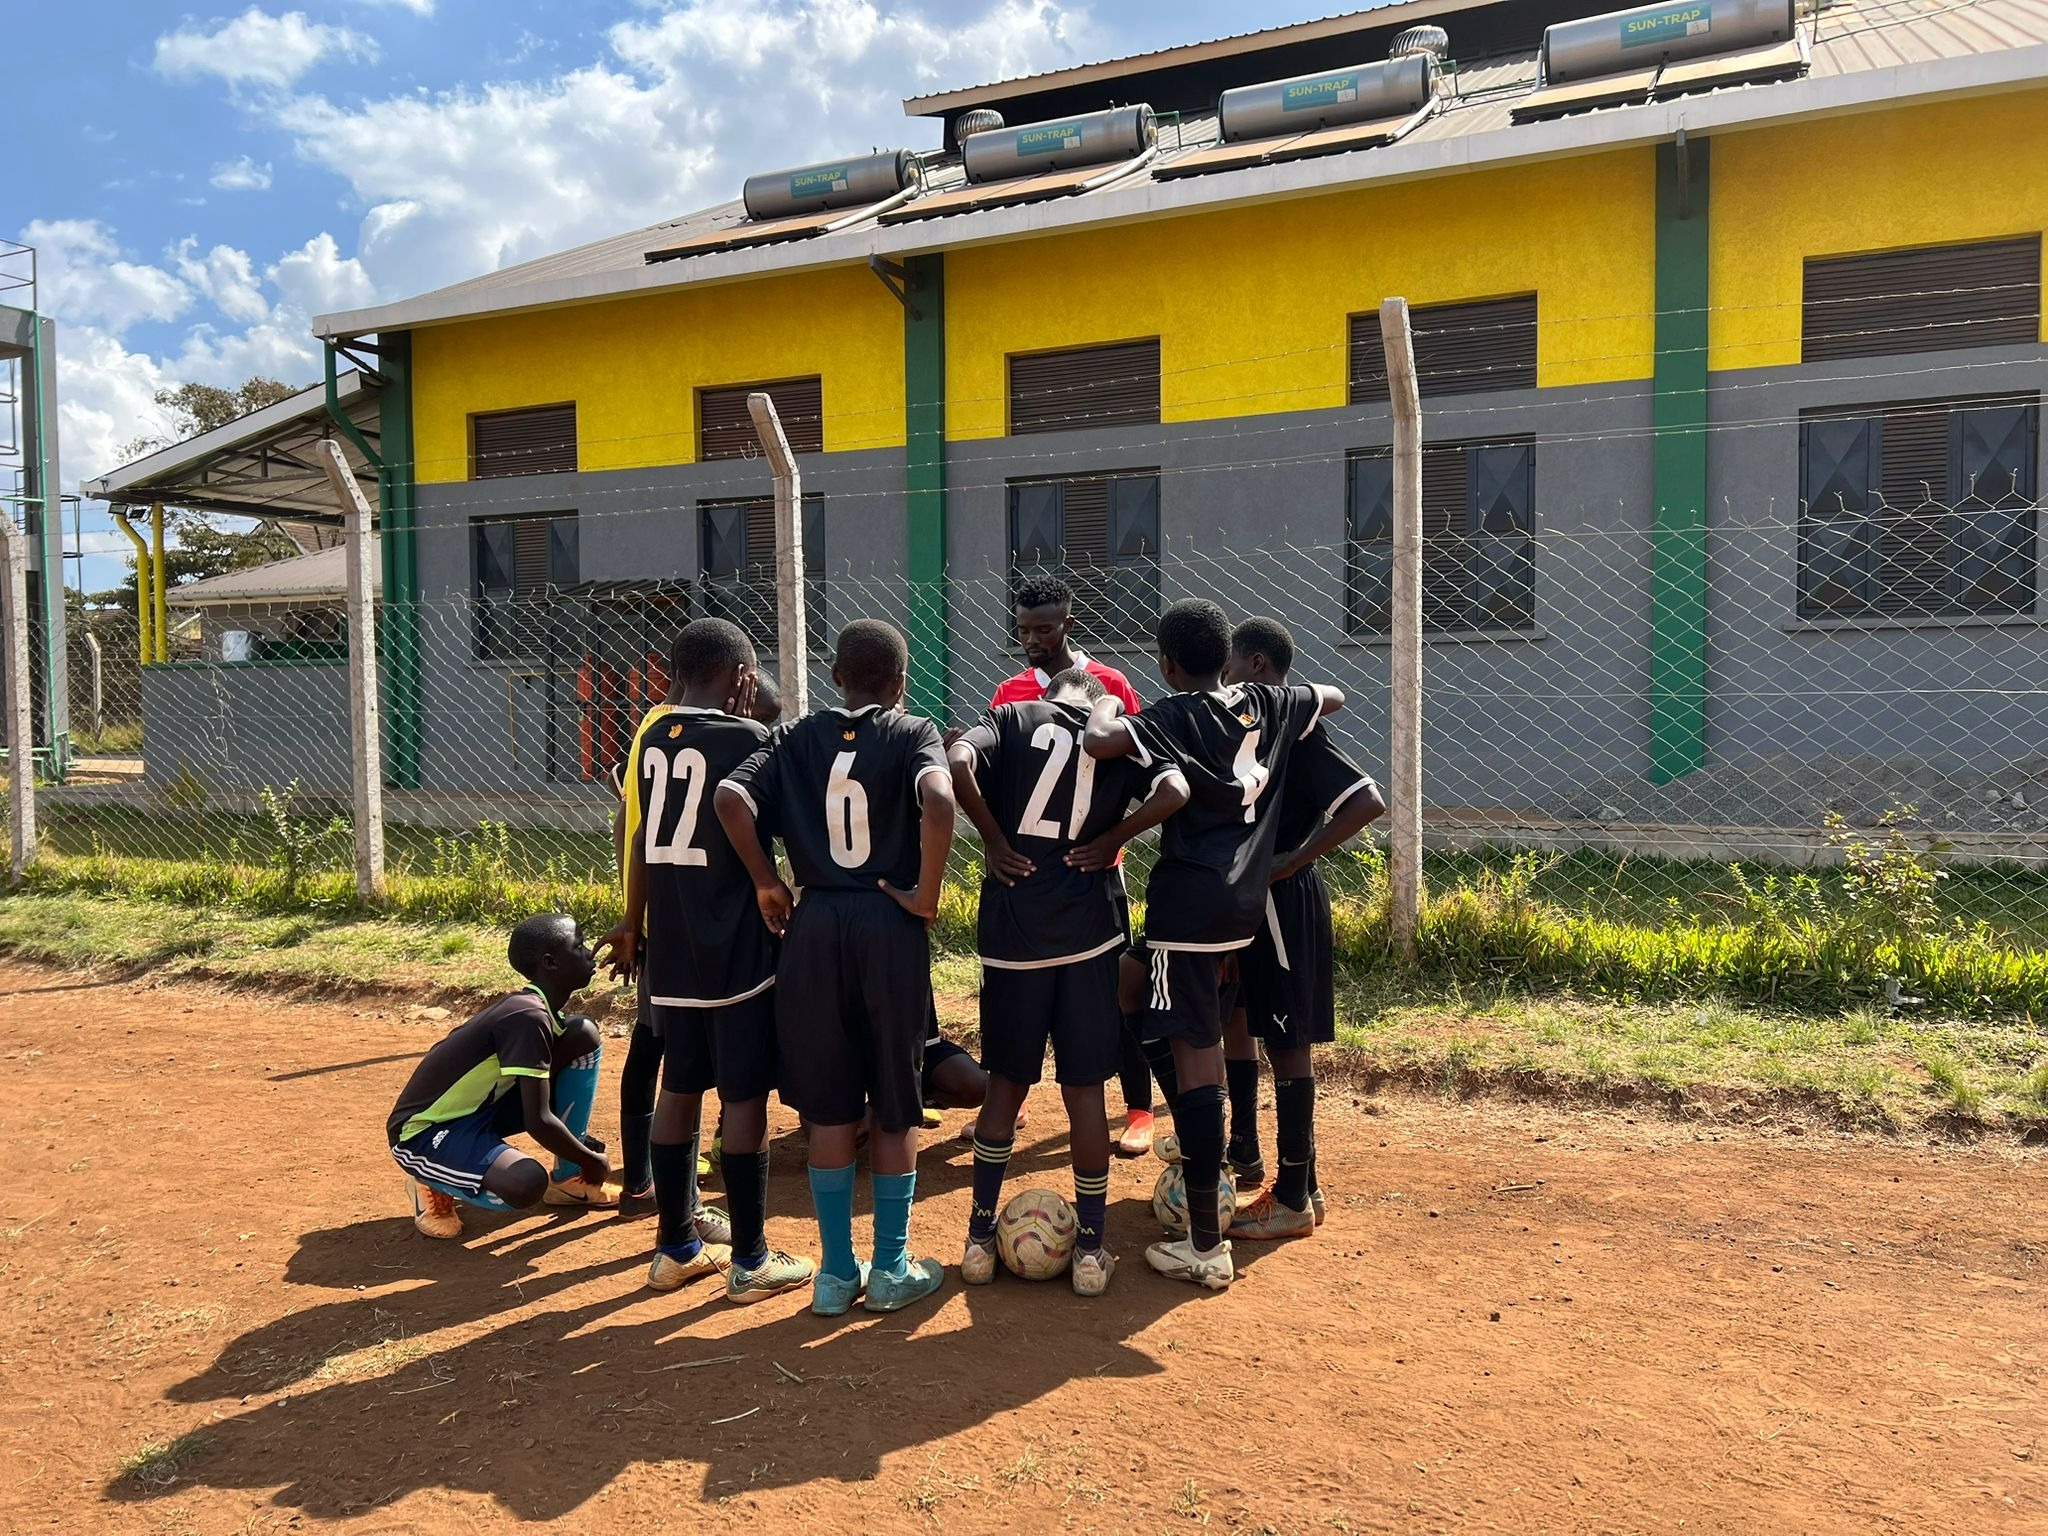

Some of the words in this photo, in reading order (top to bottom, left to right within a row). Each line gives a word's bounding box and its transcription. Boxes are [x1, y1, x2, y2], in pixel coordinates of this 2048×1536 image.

[1628, 9, 1701, 33] SUN-TRAP
[1289, 79, 1350, 98] SUN-TRAP
[1022, 128, 1074, 144] SUN-TRAP
[794, 171, 840, 187] SUN-TRAP
[1017, 722, 1096, 841] 21
[643, 746, 708, 867] 22
[826, 751, 871, 869] 6
